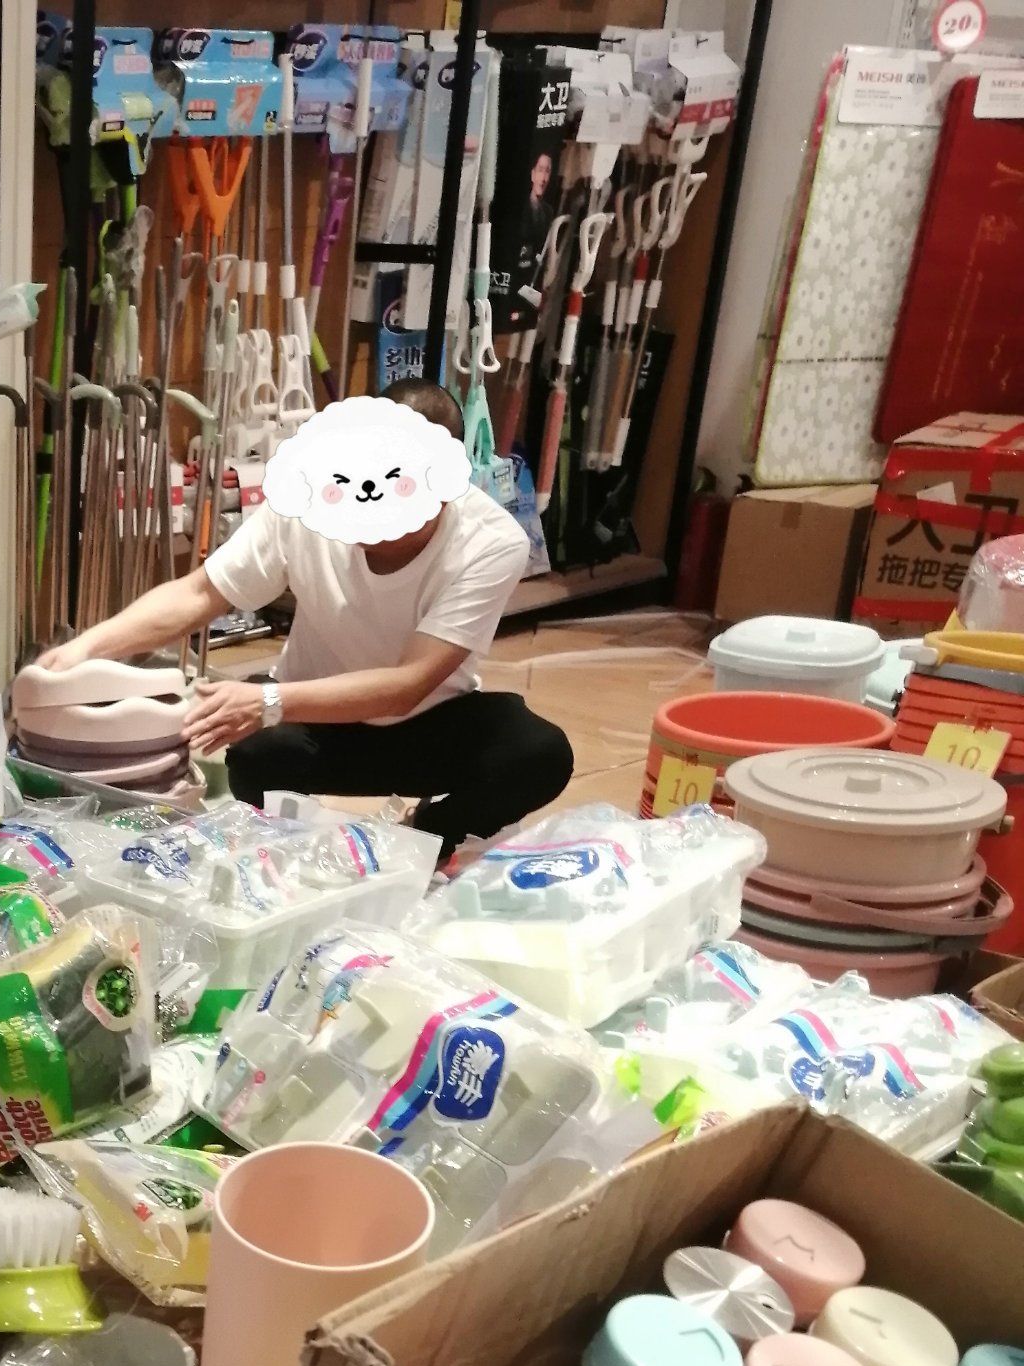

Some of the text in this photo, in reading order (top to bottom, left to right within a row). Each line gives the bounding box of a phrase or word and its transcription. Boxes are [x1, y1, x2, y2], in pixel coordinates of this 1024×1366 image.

[538, 81, 570, 112] 大卫
[876, 553, 970, 592] 拖把专
